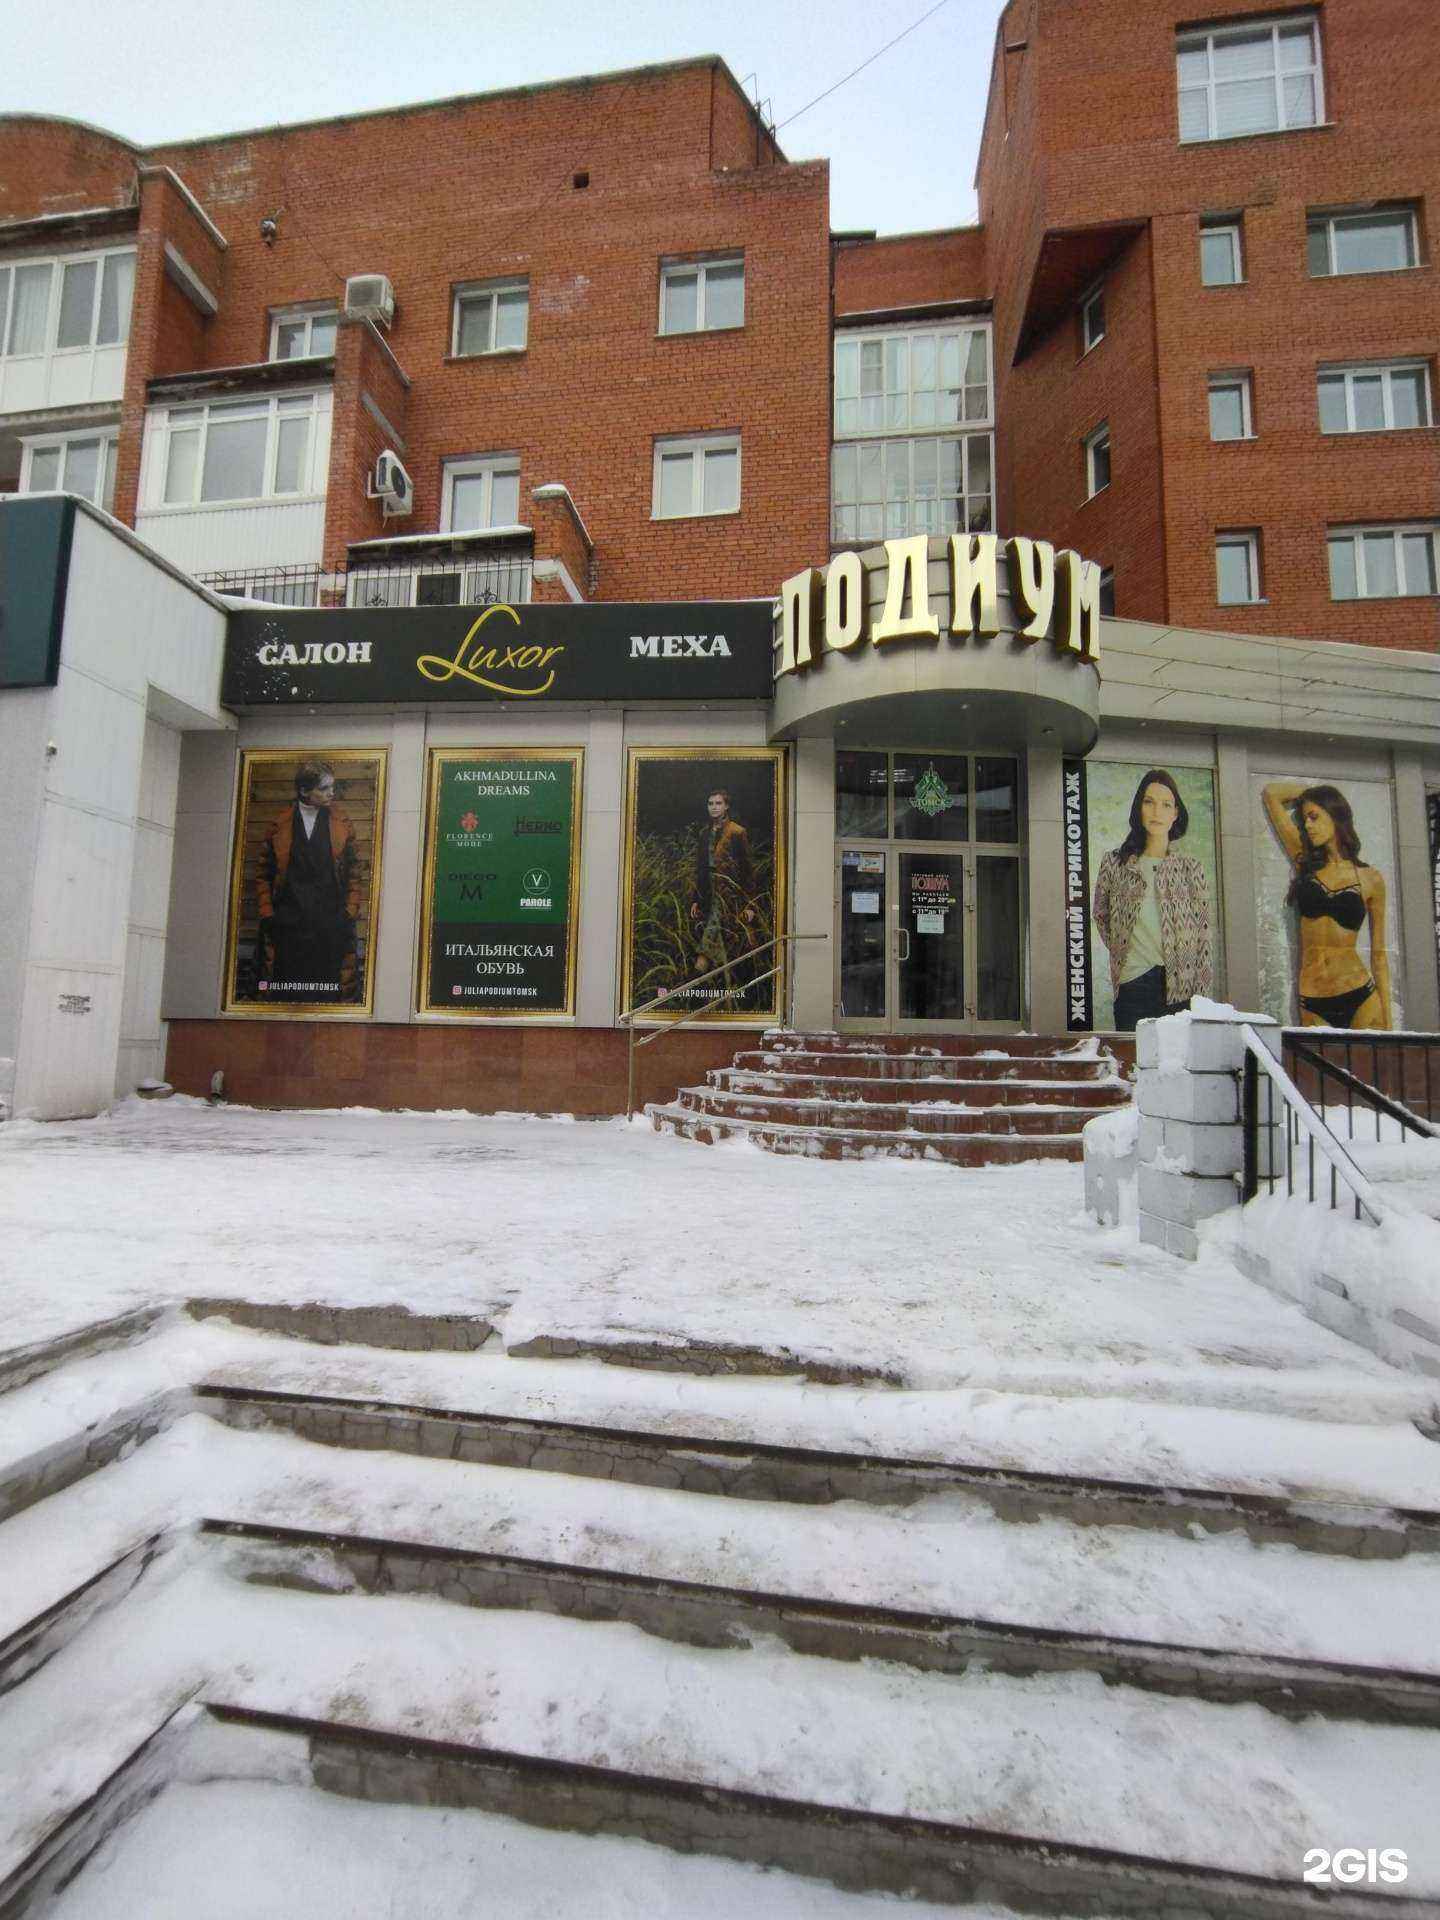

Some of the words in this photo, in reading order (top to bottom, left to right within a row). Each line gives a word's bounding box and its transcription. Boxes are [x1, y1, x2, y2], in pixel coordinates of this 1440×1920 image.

[778, 534, 1101, 675] ПОДИУМ
[257, 641, 372, 665] САЛОН
[416, 604, 564, 695] Luxor
[629, 634, 732, 658] МЕХА
[454, 771, 557, 781] AKHMADULLINA
[478, 785, 530, 796] DREAMS
[1067, 772, 1083, 901] ТРИКОТАЖ
[446, 944, 554, 957] ИТАЛЬЯНСКАЯ
[476, 962, 525, 974] ОБУВЬ
[1067, 905, 1086, 1022] ЖЕНСКИЙ
[269, 982, 339, 991] JULIAPODIUMTOMSK
[464, 986, 537, 996] JULIAPODIUMTOMSK
